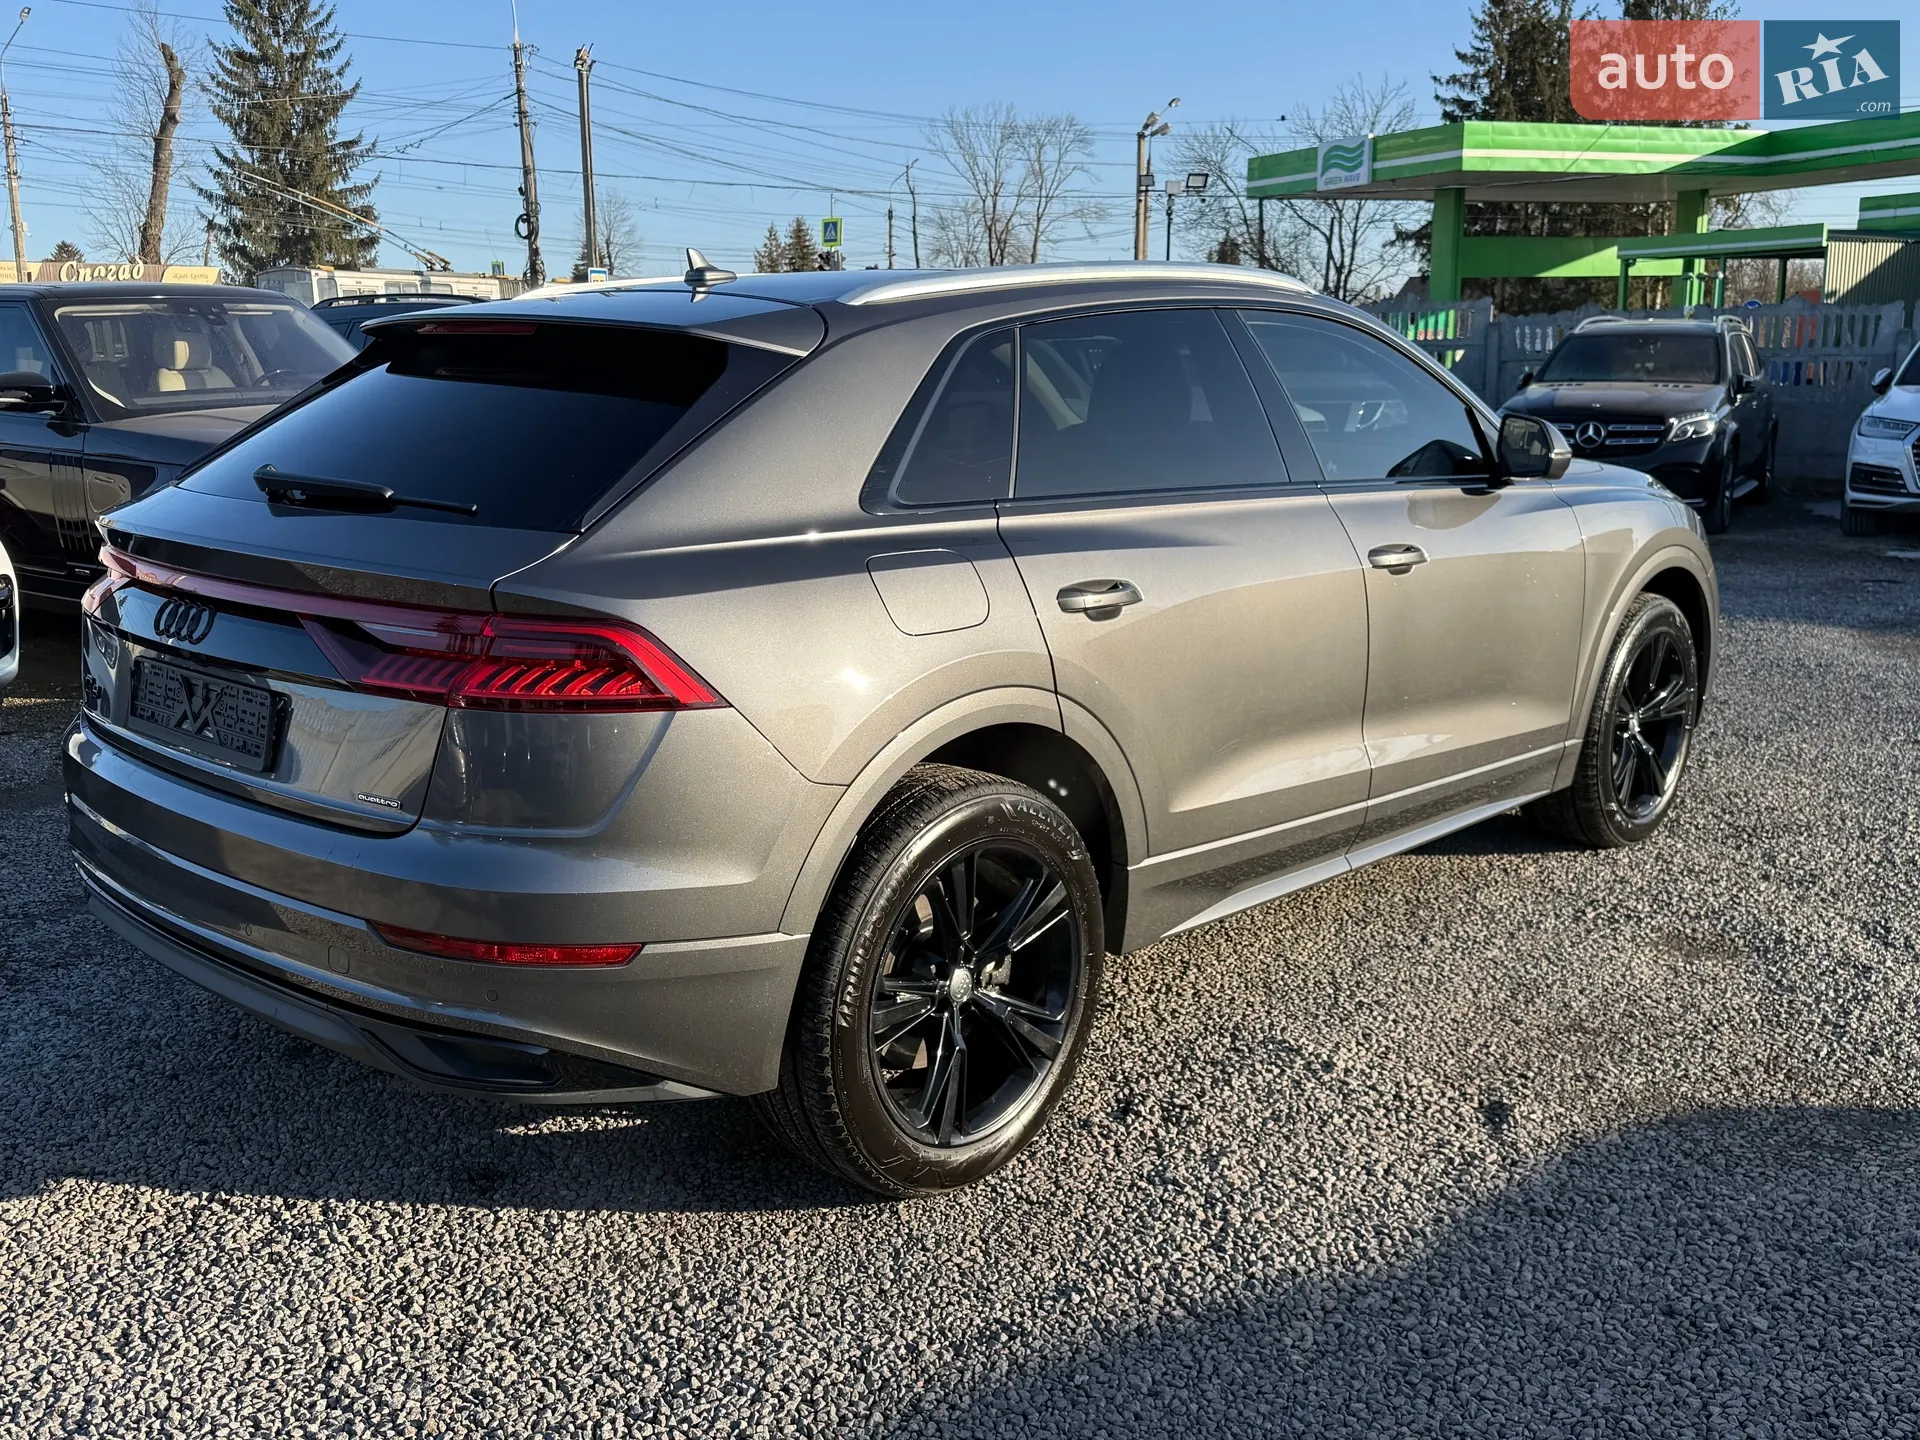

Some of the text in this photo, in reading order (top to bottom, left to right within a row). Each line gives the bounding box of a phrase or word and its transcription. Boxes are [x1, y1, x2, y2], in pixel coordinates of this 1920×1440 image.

[1323, 175, 1343, 187] GREEN
[59, 254, 145, 282] Спогад
[358, 794, 398, 808] quattro
